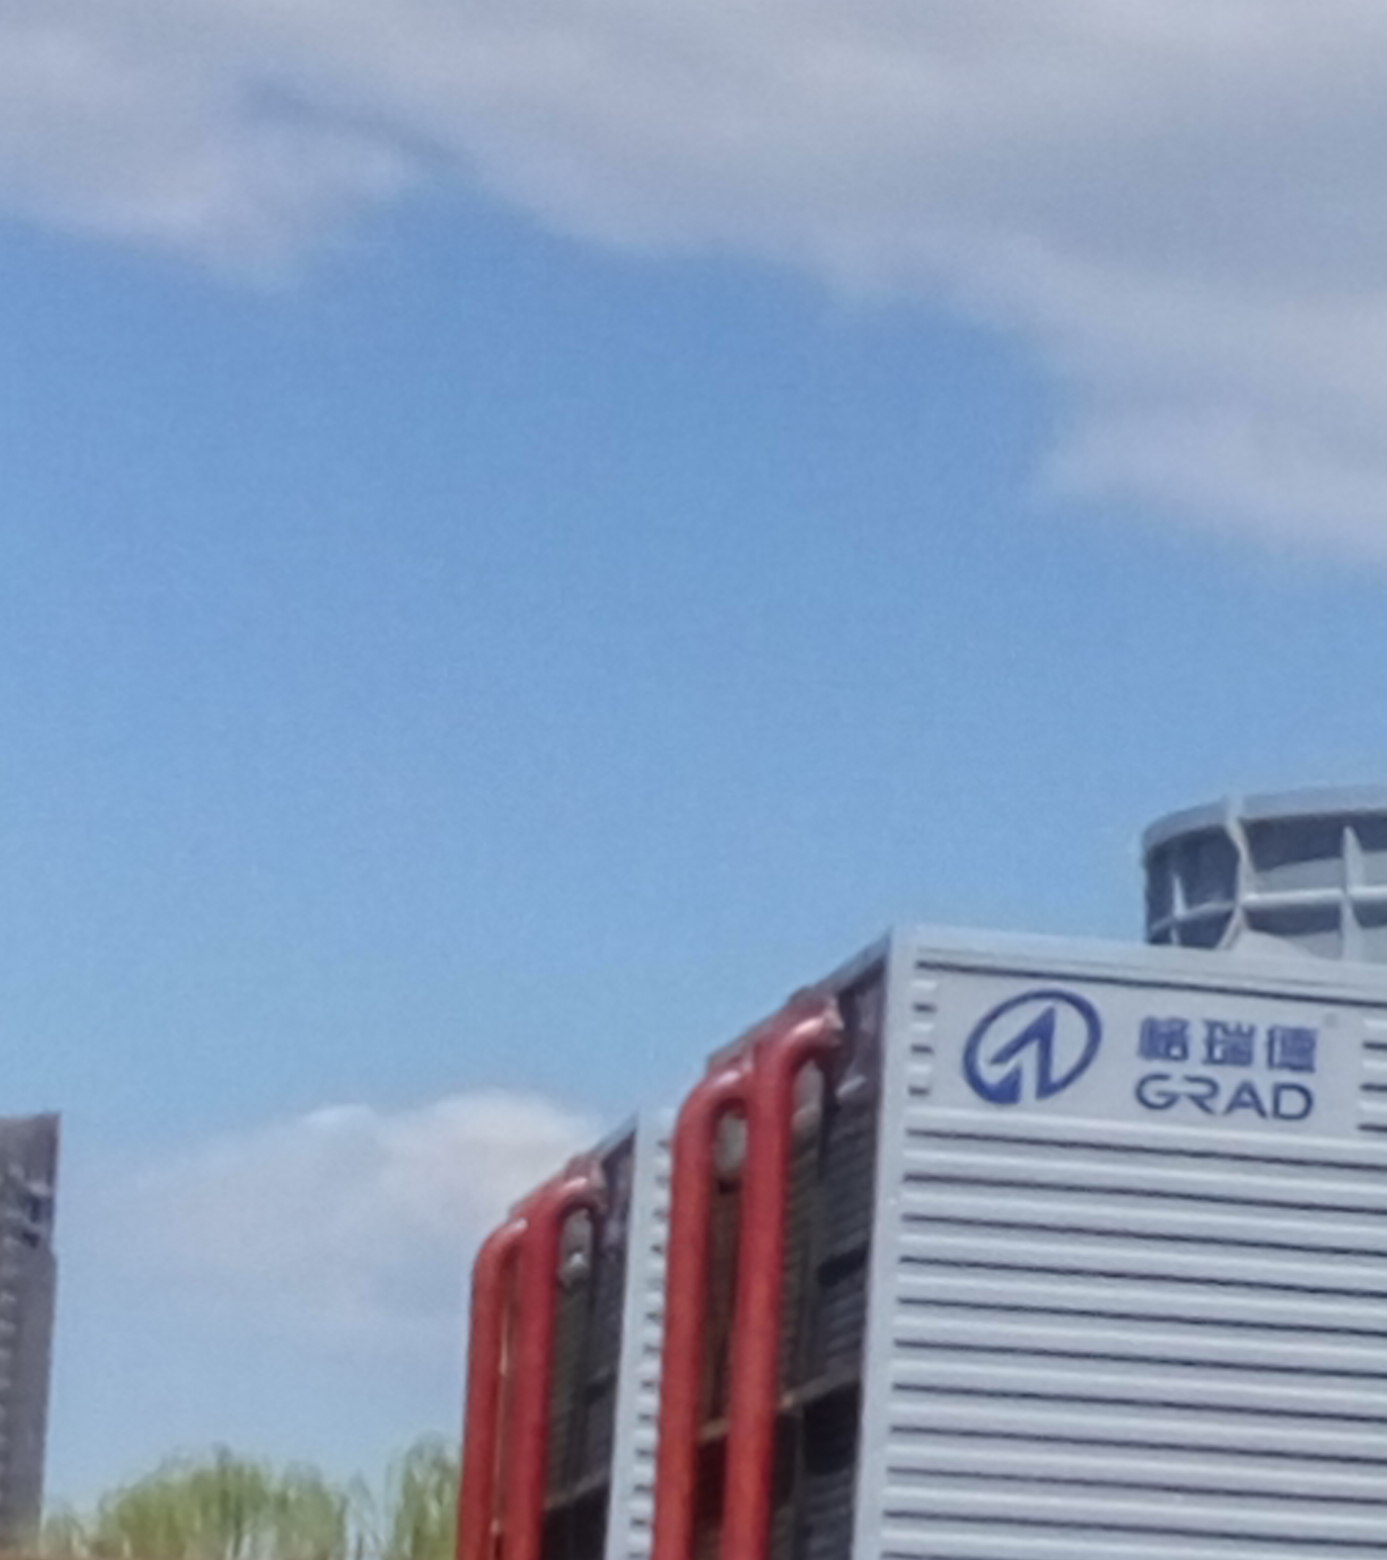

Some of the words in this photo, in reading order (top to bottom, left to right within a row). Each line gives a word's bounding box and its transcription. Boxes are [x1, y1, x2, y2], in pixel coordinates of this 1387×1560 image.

[1138, 1017, 1317, 1073] 格瑞德
[1135, 1073, 1313, 1120] GRAD
